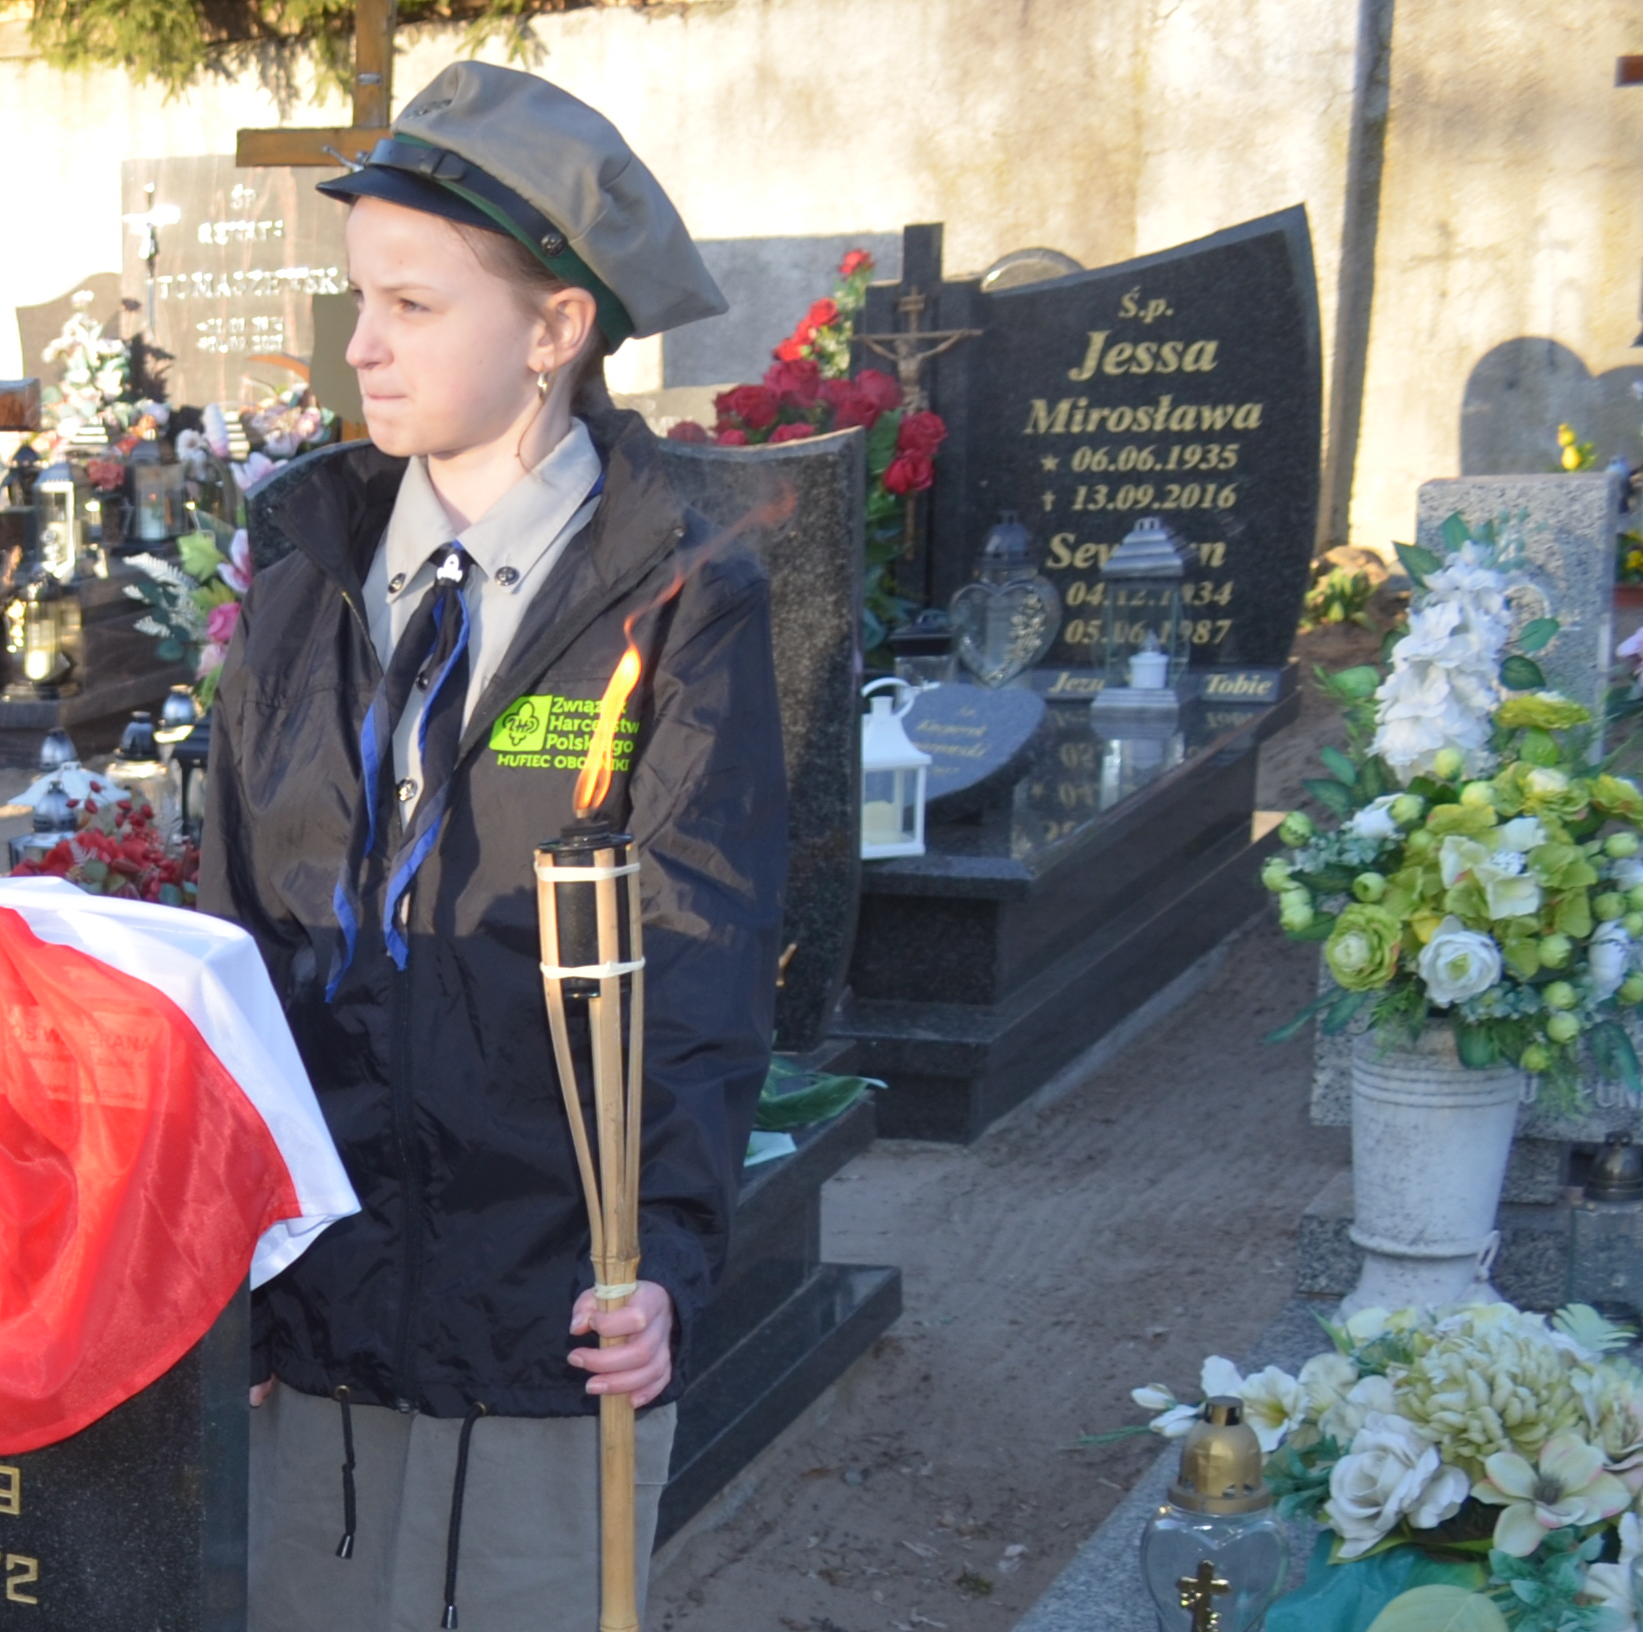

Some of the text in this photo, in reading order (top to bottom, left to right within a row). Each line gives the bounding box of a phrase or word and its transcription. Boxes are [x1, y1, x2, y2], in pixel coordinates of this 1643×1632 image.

[1117, 285, 1175, 325] Ś.p.
[1067, 330, 1220, 382] Jessa
[1023, 394, 1264, 435] Mirosława
[1070, 443, 1241, 473] 06.06.1935
[1072, 483, 1239, 511] 13.09.2016
[1204, 673, 1273, 696] Tobie
[497, 753, 551, 768] HUFIEC
